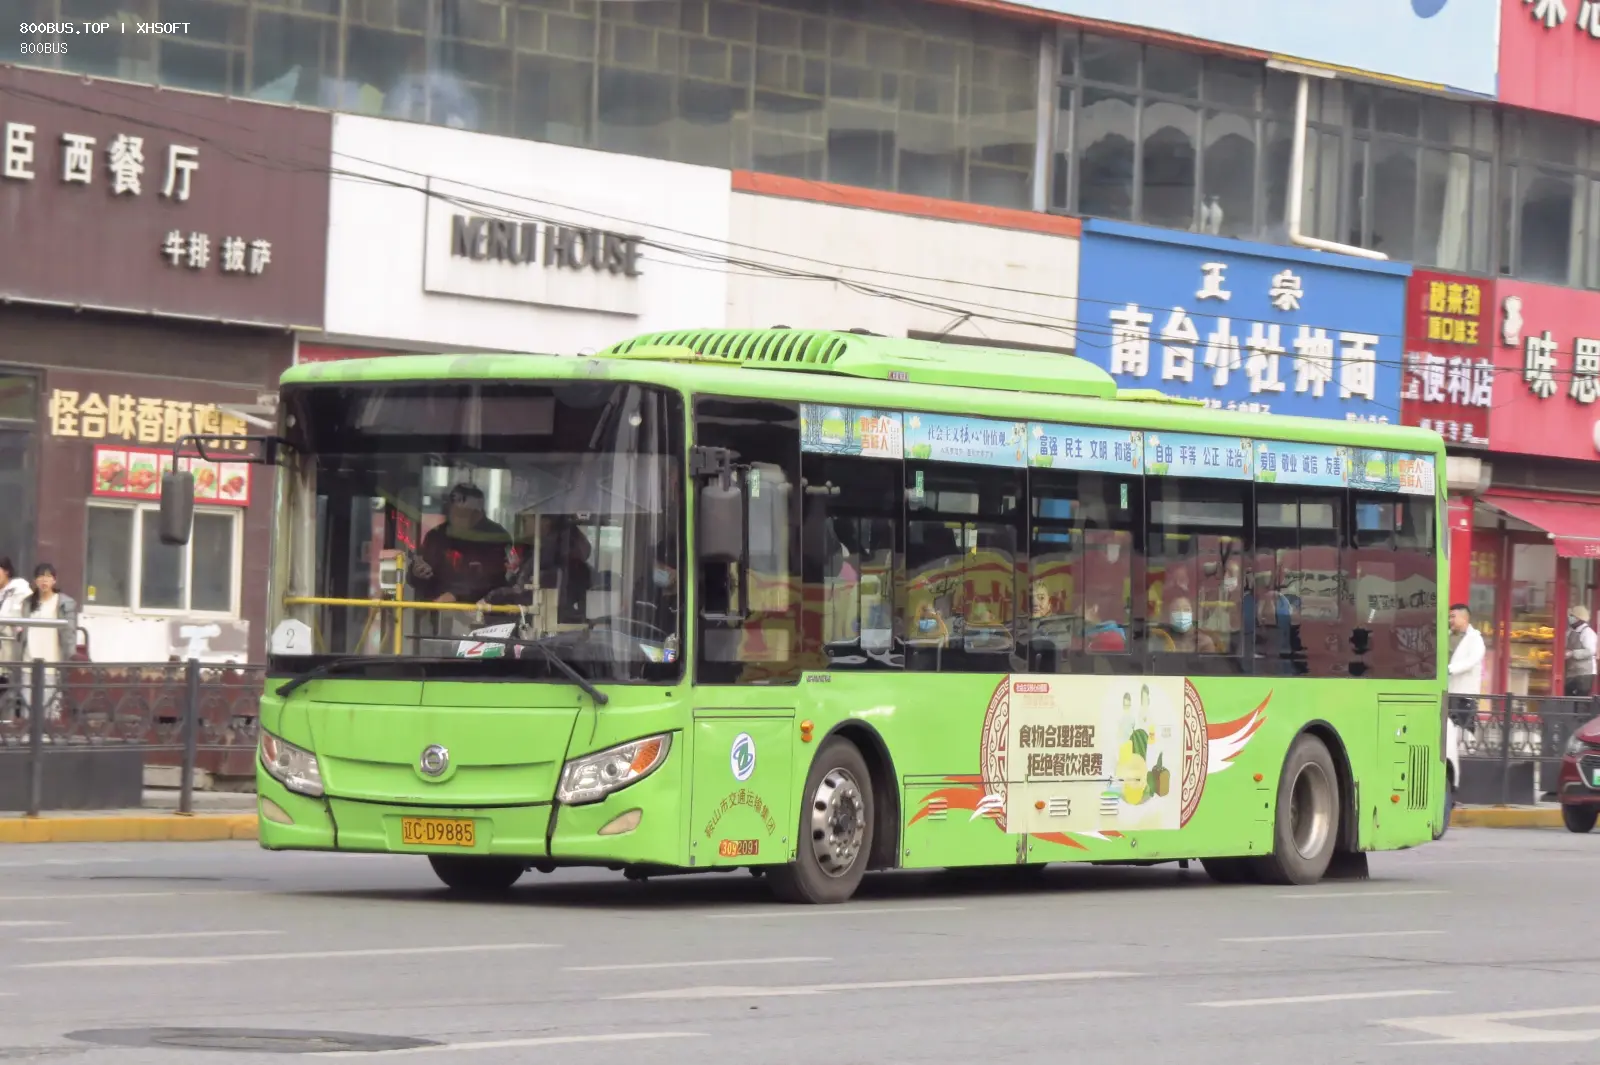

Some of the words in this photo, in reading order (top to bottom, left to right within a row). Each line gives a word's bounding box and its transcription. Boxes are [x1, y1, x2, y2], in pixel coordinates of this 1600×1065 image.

[4, 122, 199, 201] 臣西餐厅
[165, 230, 210, 268] 牛排
[223, 236, 271, 274] 披萨
[543, 225, 644, 277] HOUSE
[1195, 262, 1304, 311] 正宗
[928, 424, 1006, 447] 社会主义核心价值观
[1039, 435, 1058, 456] 富强
[1066, 438, 1083, 459] 民主
[1090, 440, 1108, 460] 文明
[1114, 442, 1132, 462] 和谐
[1156, 444, 1173, 464] 自由
[1180, 445, 1196, 465] 平等
[1203, 447, 1219, 466] 公正
[1226, 448, 1243, 468] 法治
[1261, 453, 1276, 472] 爱国
[1282, 454, 1297, 473] 敬业
[1302, 455, 1318, 474] 诚信
[1325, 455, 1341, 475] 友善
[286, 628, 295, 649] 2
[1019, 724, 1095, 748] 食物合理搭配
[1027, 753, 1103, 777] 拒绝餐饮浪费
